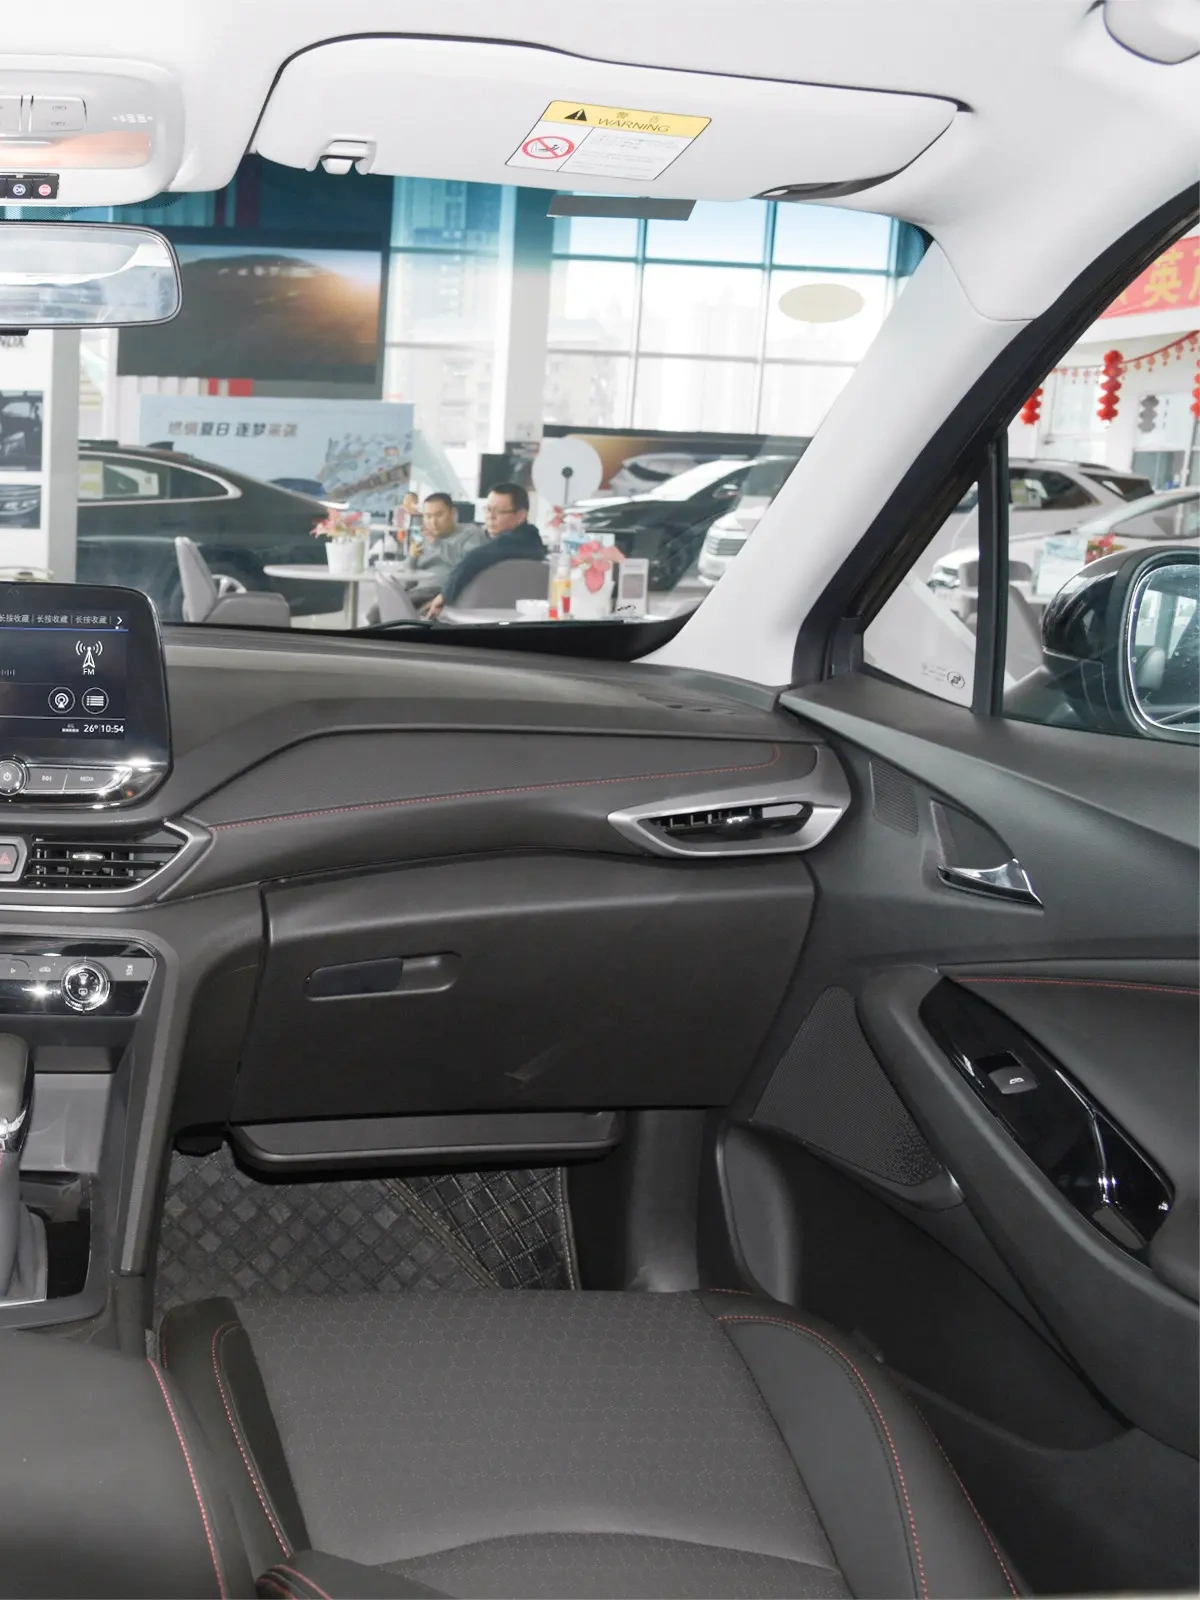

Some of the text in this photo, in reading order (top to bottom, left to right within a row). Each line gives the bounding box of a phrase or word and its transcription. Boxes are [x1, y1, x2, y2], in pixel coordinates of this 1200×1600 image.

[597, 118, 671, 133] WARNING
[83, 668, 95, 676] FM
[101, 724, 125, 733] 10:54
